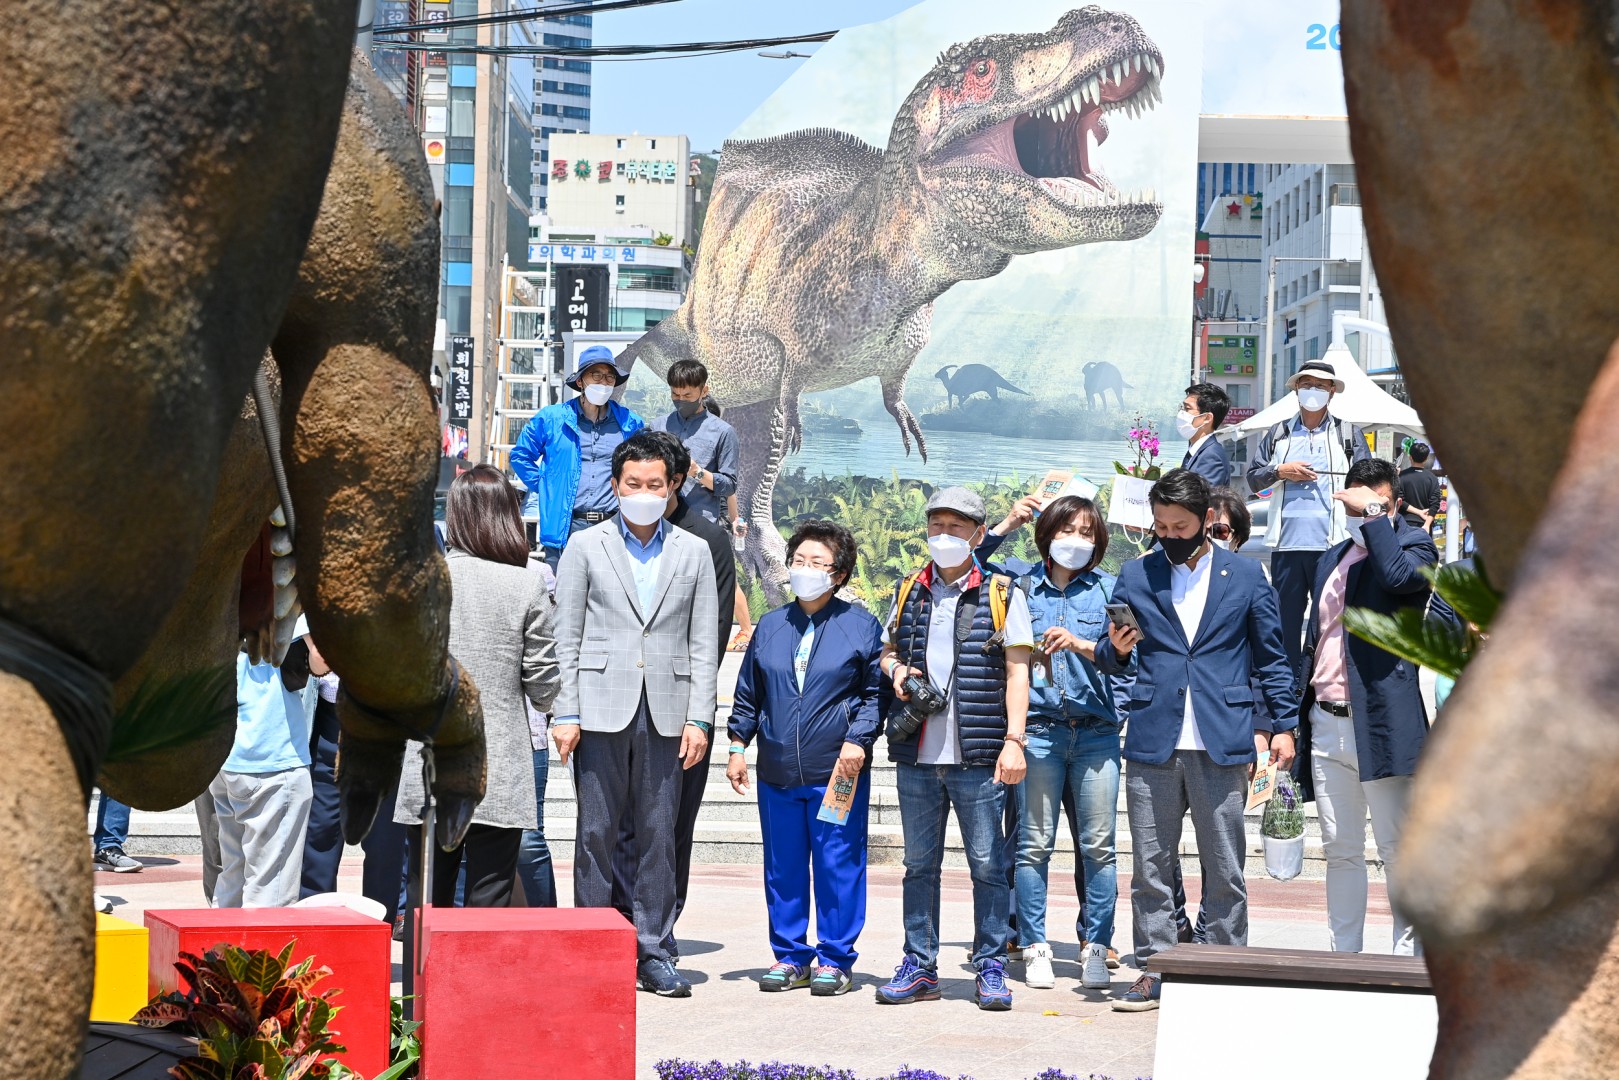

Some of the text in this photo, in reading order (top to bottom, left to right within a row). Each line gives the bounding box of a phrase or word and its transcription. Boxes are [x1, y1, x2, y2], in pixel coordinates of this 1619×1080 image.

[428, 12, 444, 20] GS
[455, 351, 471, 417] 회전초밥
[1092, 949, 1100, 957] M
